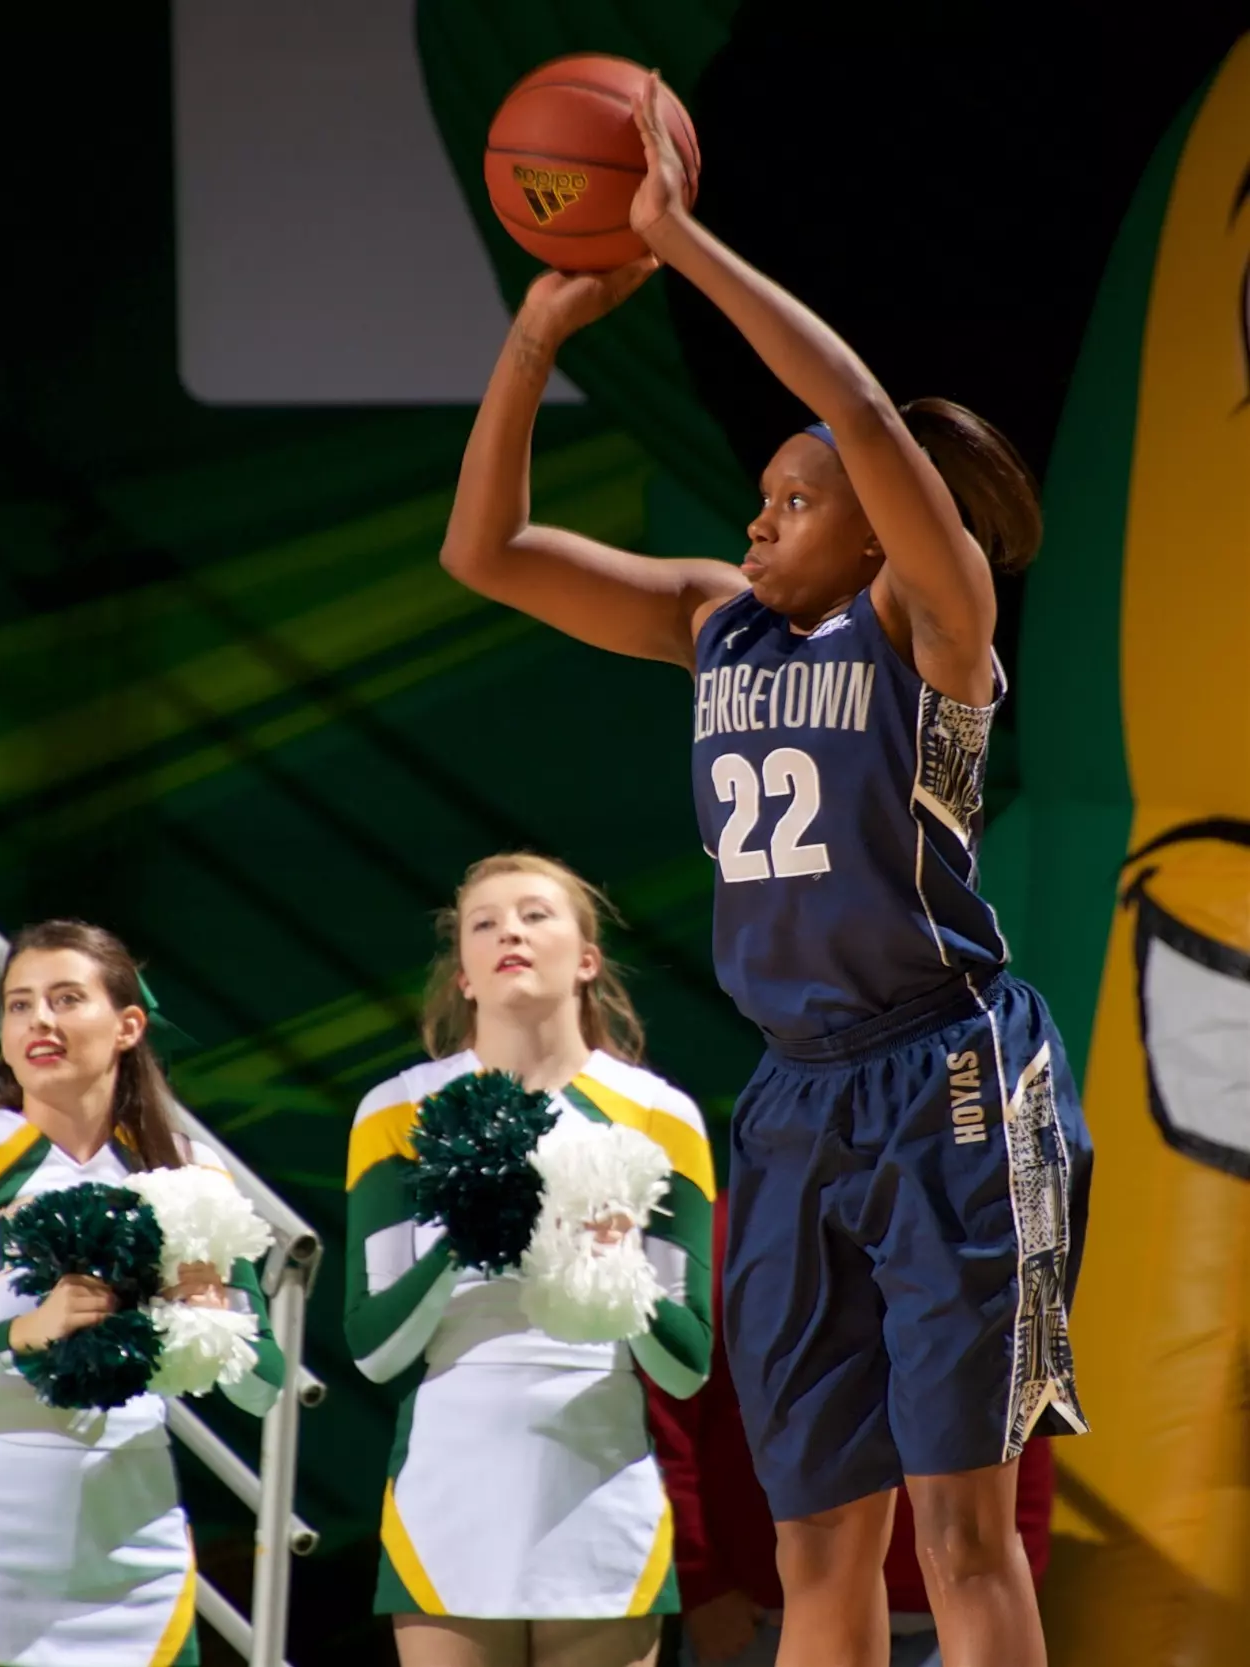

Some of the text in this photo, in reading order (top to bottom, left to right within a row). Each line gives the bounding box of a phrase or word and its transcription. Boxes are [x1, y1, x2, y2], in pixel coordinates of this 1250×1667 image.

[513, 164, 588, 192] adidas
[694, 660, 876, 743] EORGETOWN
[711, 747, 831, 883] 22
[946, 1050, 988, 1145] HOYAS
